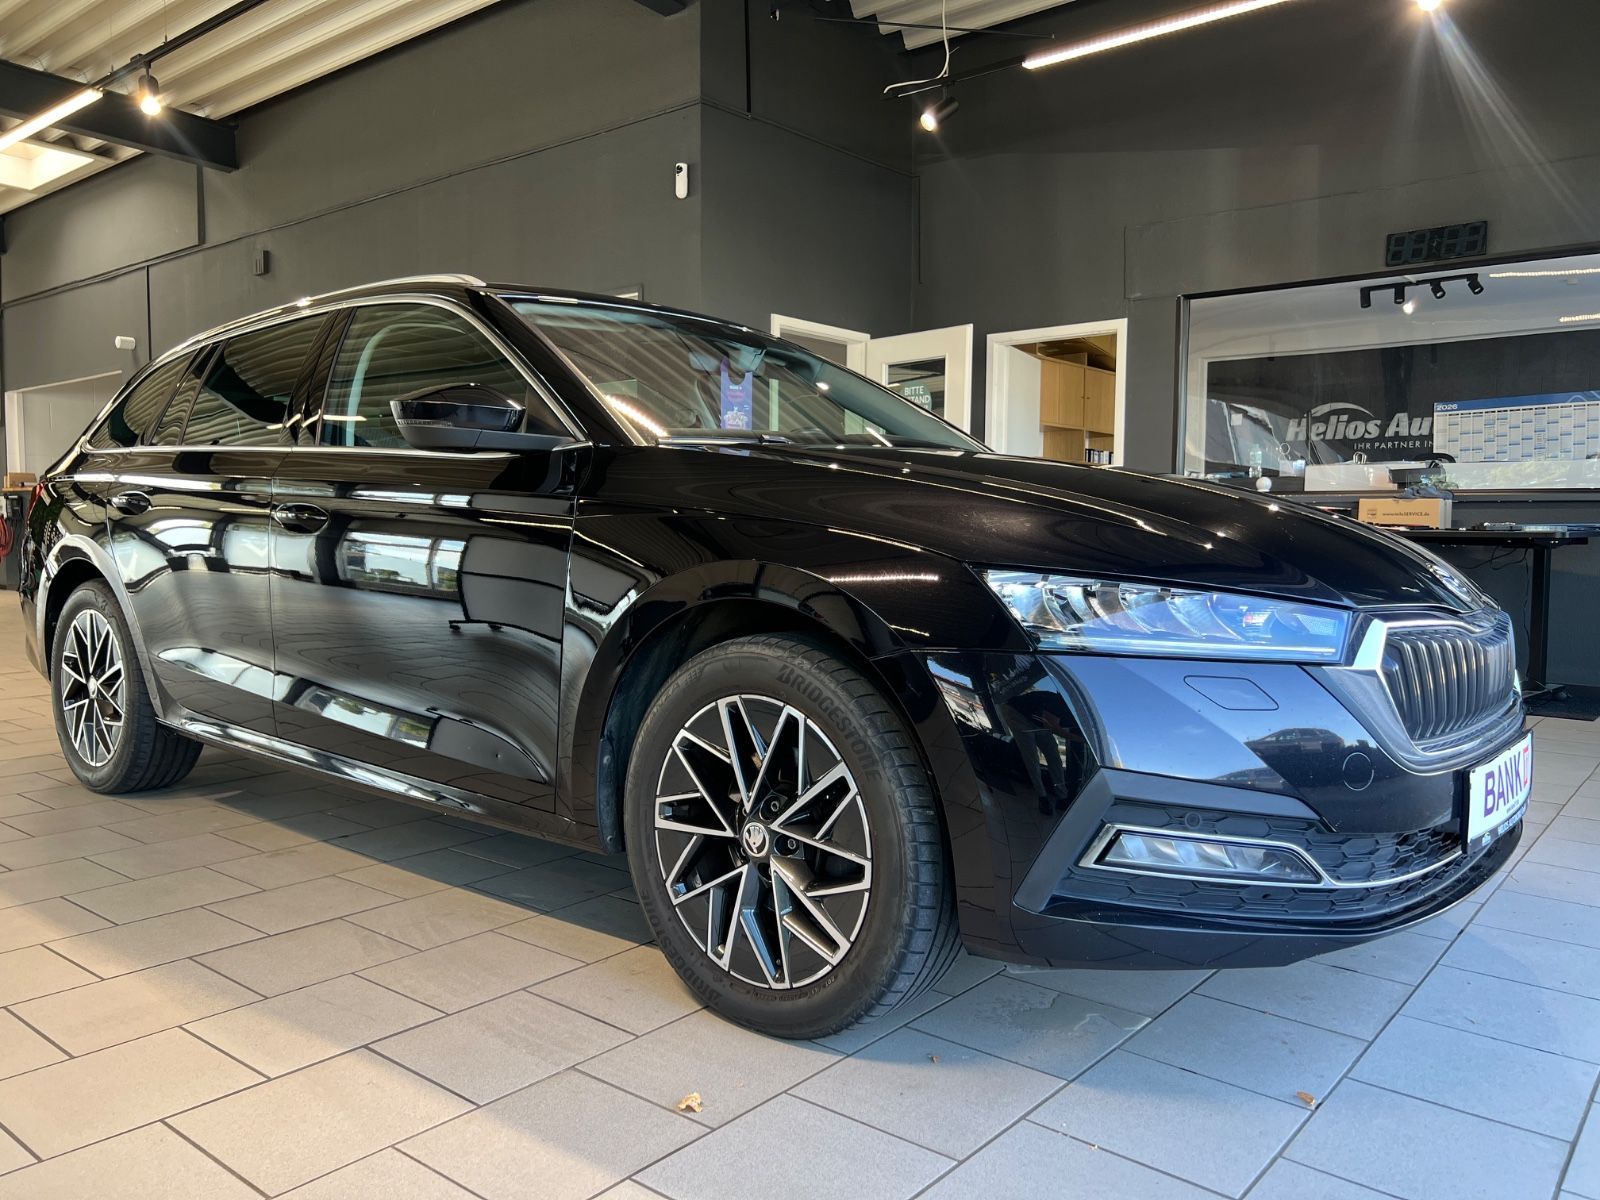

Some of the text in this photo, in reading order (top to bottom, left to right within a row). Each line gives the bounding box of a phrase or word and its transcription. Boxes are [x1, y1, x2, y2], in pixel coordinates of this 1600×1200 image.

[904, 386, 924, 396] BITTE
[1436, 403, 1458, 411] 2026
[1285, 412, 1434, 442] Helios Au
[1353, 442, 1371, 451] IHR
[1374, 440, 1421, 450] PARTNER
[776, 663, 883, 780] BRIDGESTONE
[1484, 751, 1522, 818] BANK
